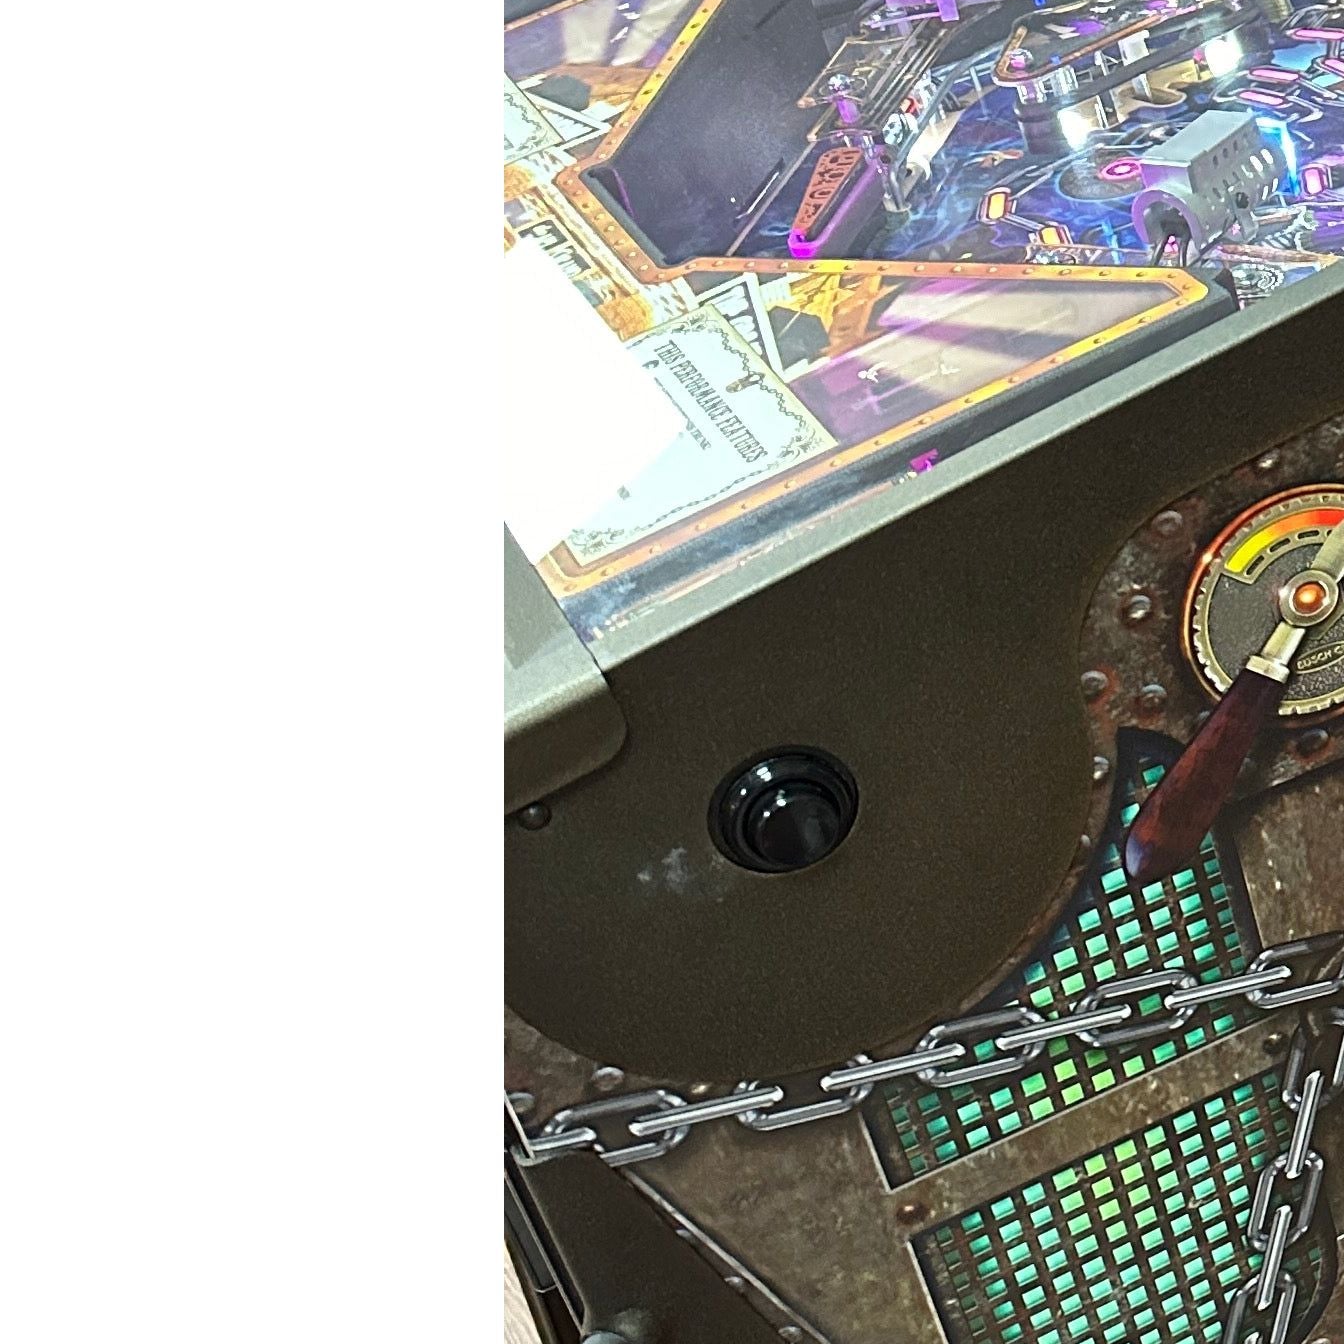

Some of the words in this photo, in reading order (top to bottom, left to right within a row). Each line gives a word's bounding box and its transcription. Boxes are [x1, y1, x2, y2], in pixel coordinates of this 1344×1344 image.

[653, 338, 686, 367] THIS
[668, 358, 733, 423] PERFORMANCE
[714, 413, 769, 464] FEATURES
